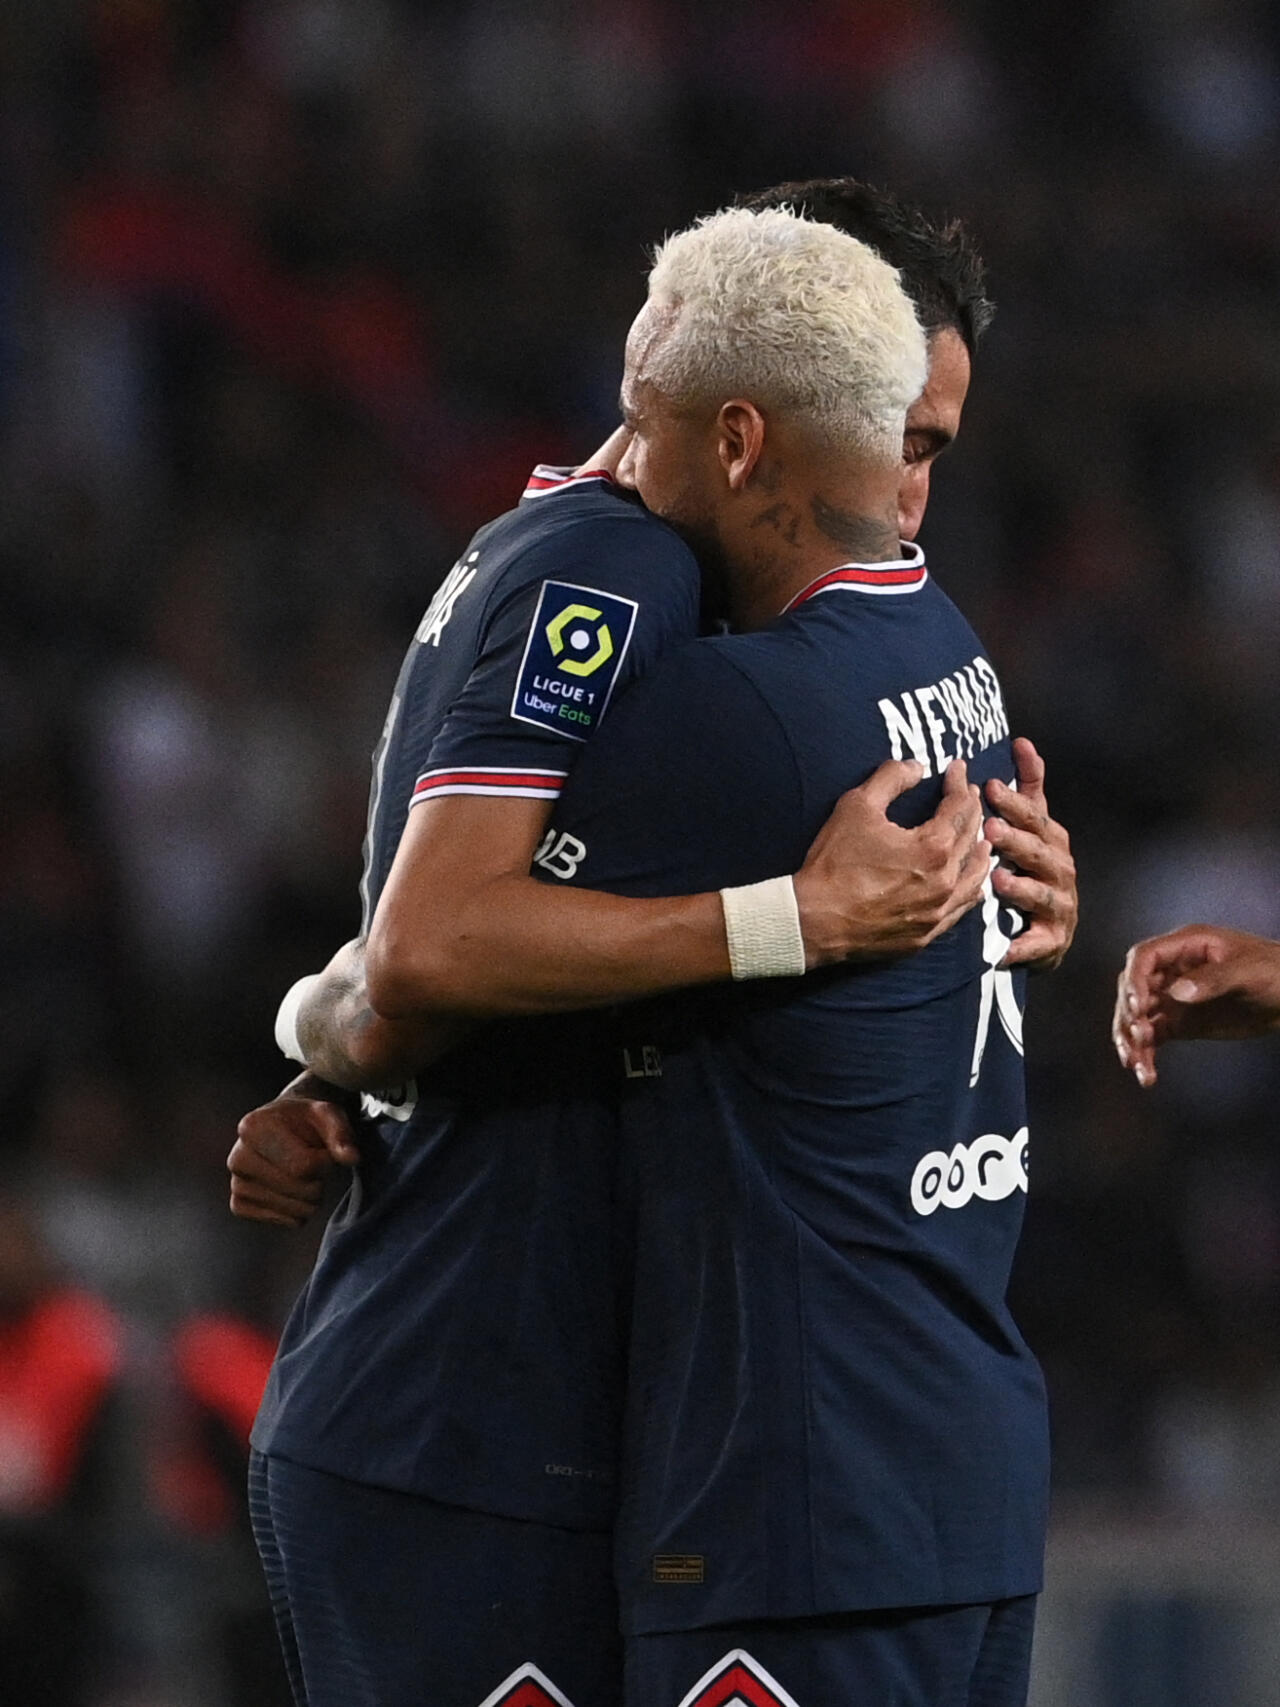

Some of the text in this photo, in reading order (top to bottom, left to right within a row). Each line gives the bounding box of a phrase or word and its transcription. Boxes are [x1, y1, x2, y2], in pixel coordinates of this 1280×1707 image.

[532, 674, 596, 706] LIGUE 1
[523, 691, 592, 726] Uber Eats
